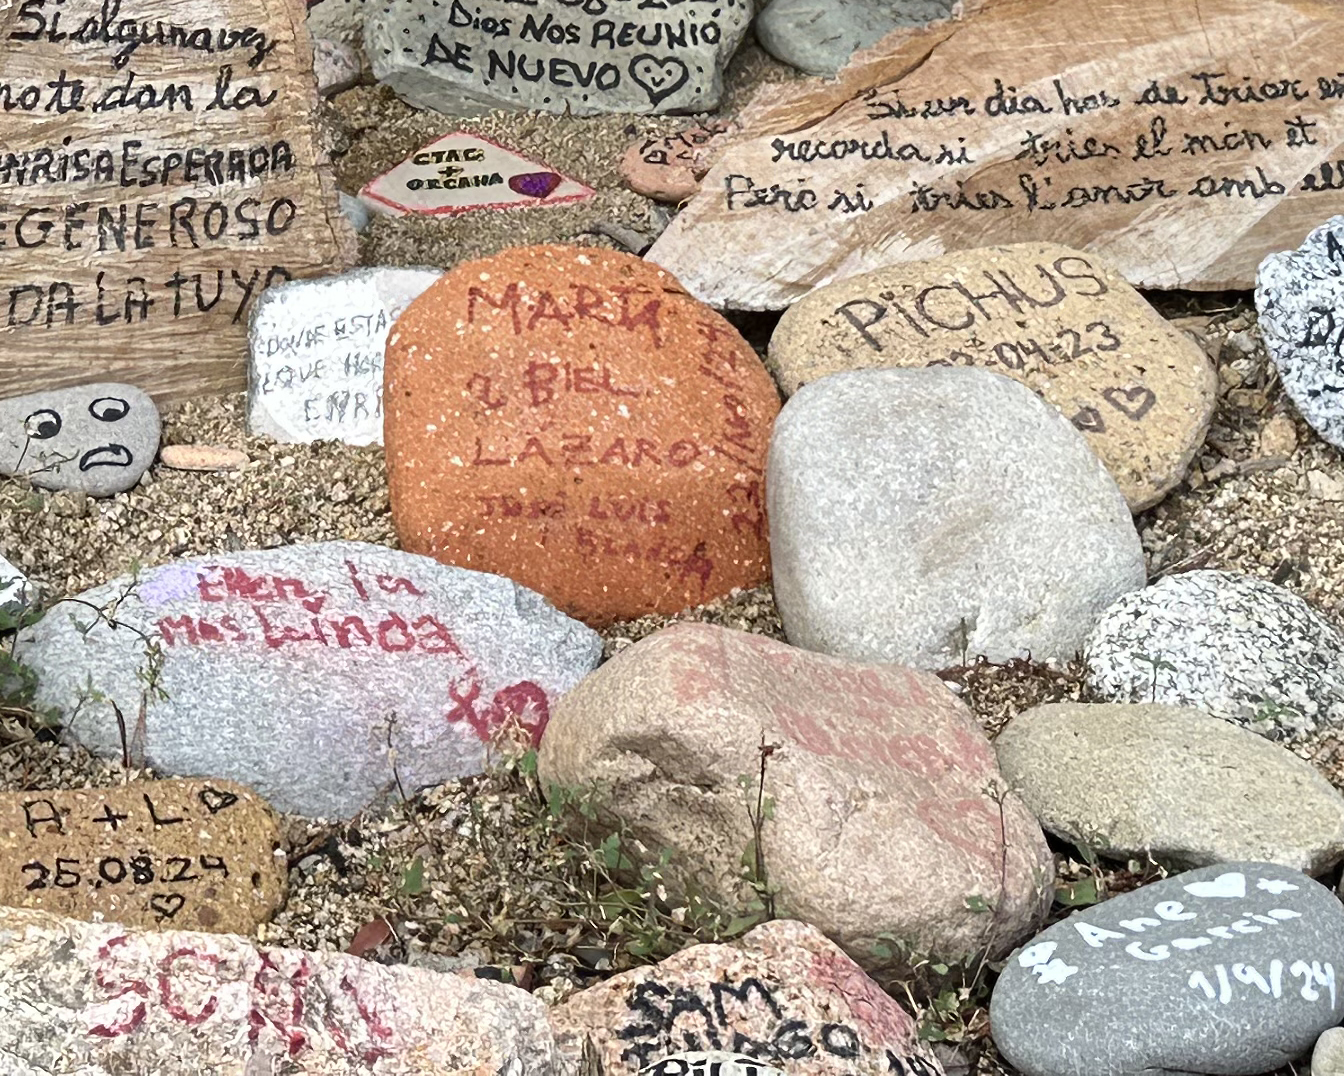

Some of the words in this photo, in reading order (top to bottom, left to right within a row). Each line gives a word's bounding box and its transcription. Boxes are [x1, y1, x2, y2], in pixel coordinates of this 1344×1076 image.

[43, 69, 87, 114] te
[91, 70, 195, 114] dan
[205, 63, 280, 112] la
[422, 32, 475, 75] DE
[487, 48, 622, 91] NUEVO
[770, 129, 932, 164] recorda
[933, 136, 977, 166] si
[1131, 114, 1175, 163] el
[826, 182, 875, 214] si
[1187, 165, 1288, 200] amb
[14, 195, 299, 253] GENEROSO
[8, 281, 83, 329] DA
[95, 270, 156, 325] LA
